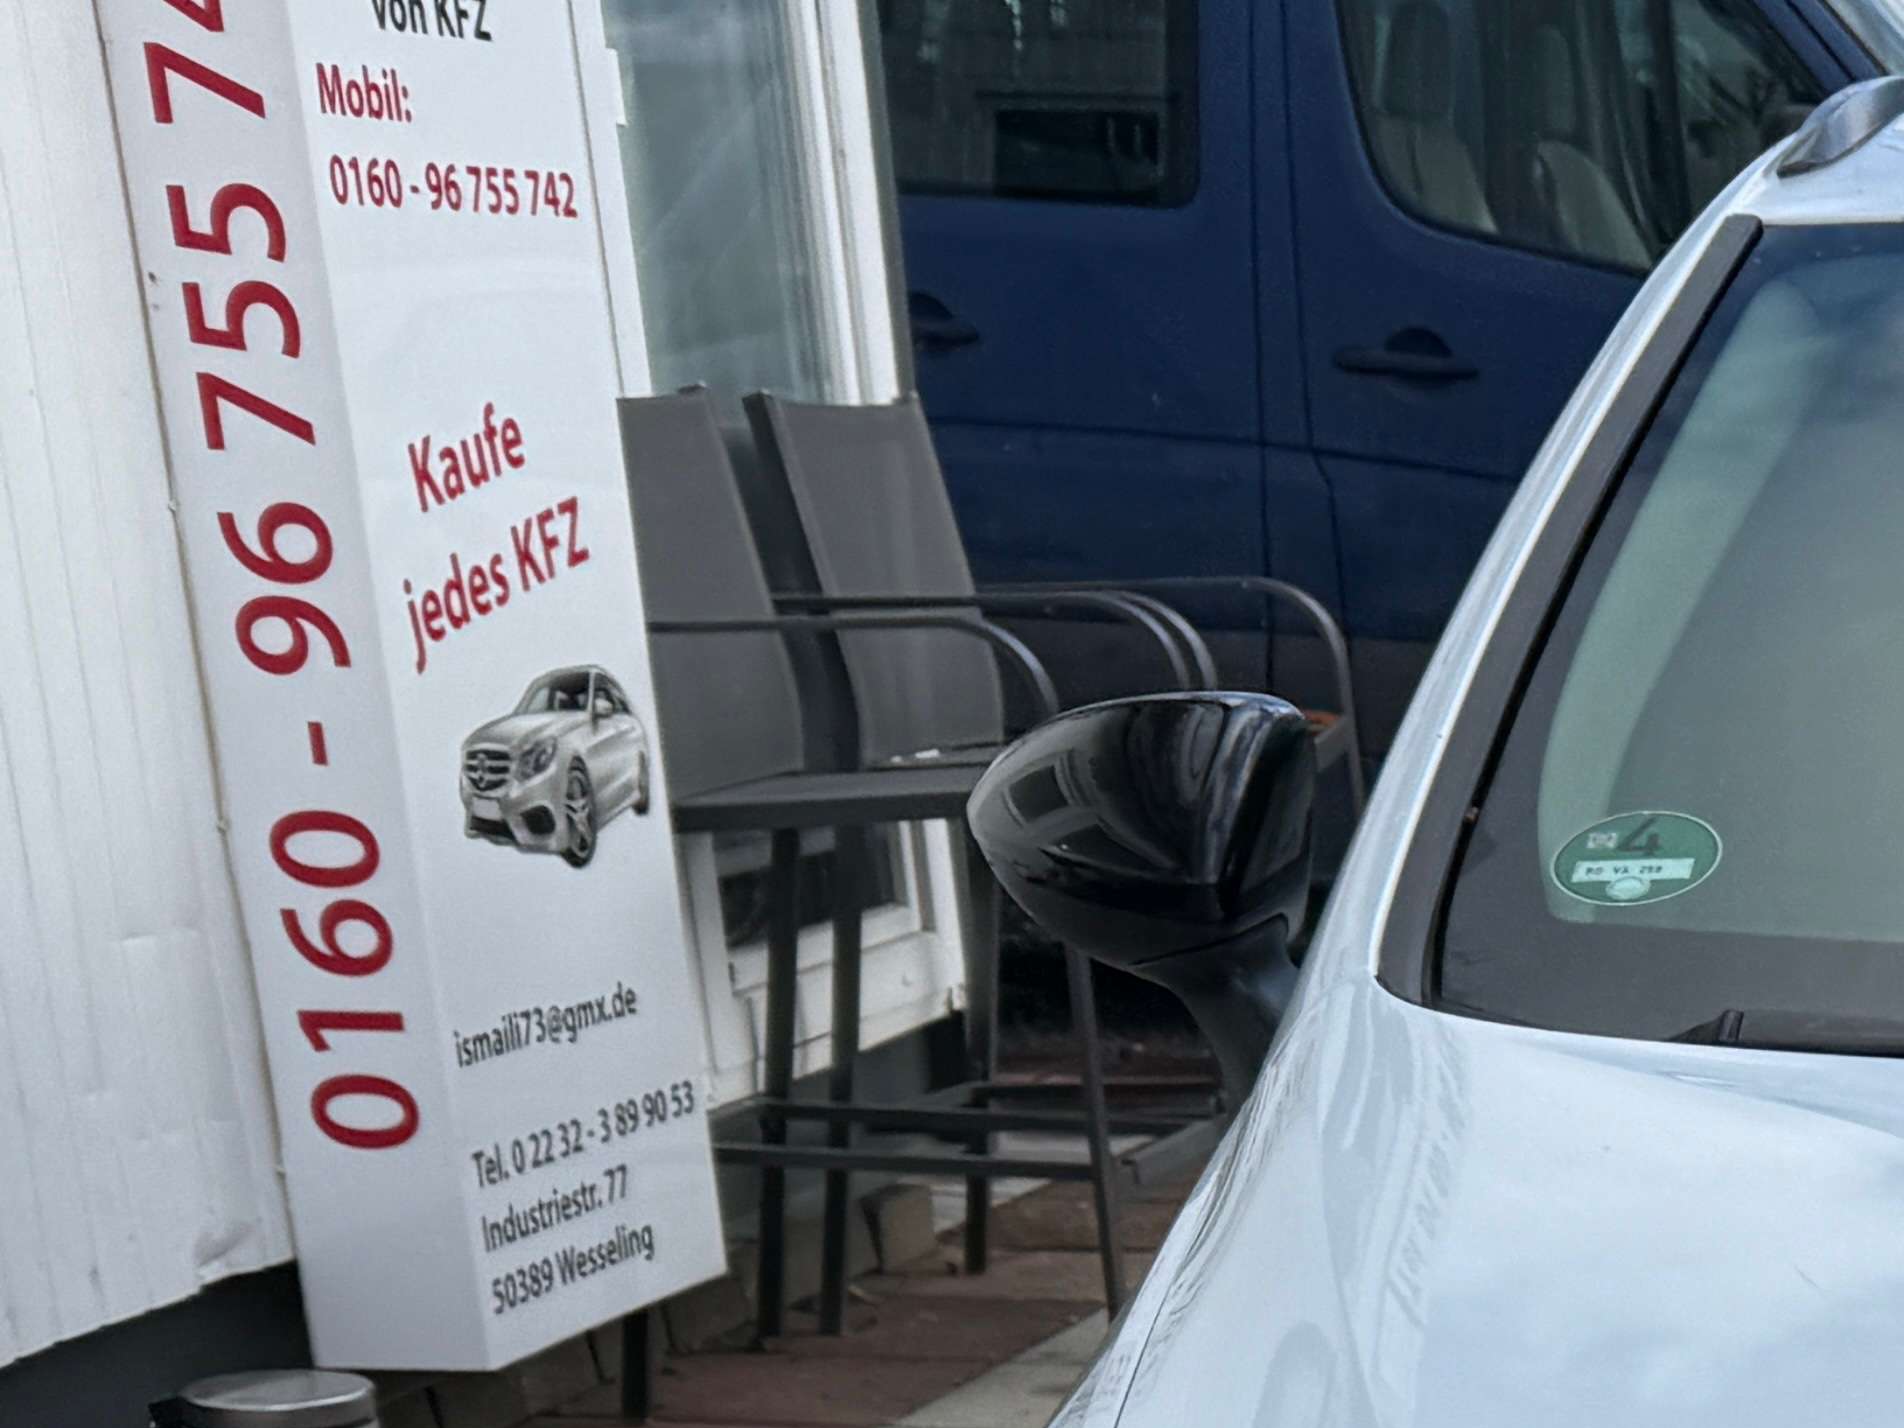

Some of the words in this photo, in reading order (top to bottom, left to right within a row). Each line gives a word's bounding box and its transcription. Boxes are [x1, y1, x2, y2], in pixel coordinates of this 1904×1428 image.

[434, 0, 493, 41] KFZ
[315, 62, 412, 123] Mobil:
[329, 154, 403, 208] 0160
[425, 162, 462, 211] 96
[466, 165, 520, 215] 755
[524, 170, 578, 218] 742
[165, 182, 316, 451] 755
[407, 401, 526, 513] Kaufe
[217, 502, 352, 676] 96
[403, 552, 510, 675] jedes
[510, 496, 590, 592] KFZ
[269, 809, 420, 1150] 0160
[453, 980, 638, 1068] ismaili73@gmx.de
[472, 1142, 510, 1188] Tel.
[512, 1139, 526, 1175] 0
[530, 1129, 555, 1169] 22
[557, 1118, 584, 1159] 32
[598, 1109, 612, 1143] 3
[615, 1099, 640, 1137] 89
[643, 1089, 668, 1128] 90
[671, 1080, 695, 1118] 53
[481, 1181, 603, 1253] Industriestr.
[603, 1164, 628, 1201] 77
[491, 1258, 555, 1315] 50389
[555, 1224, 655, 1285] Wesseling
